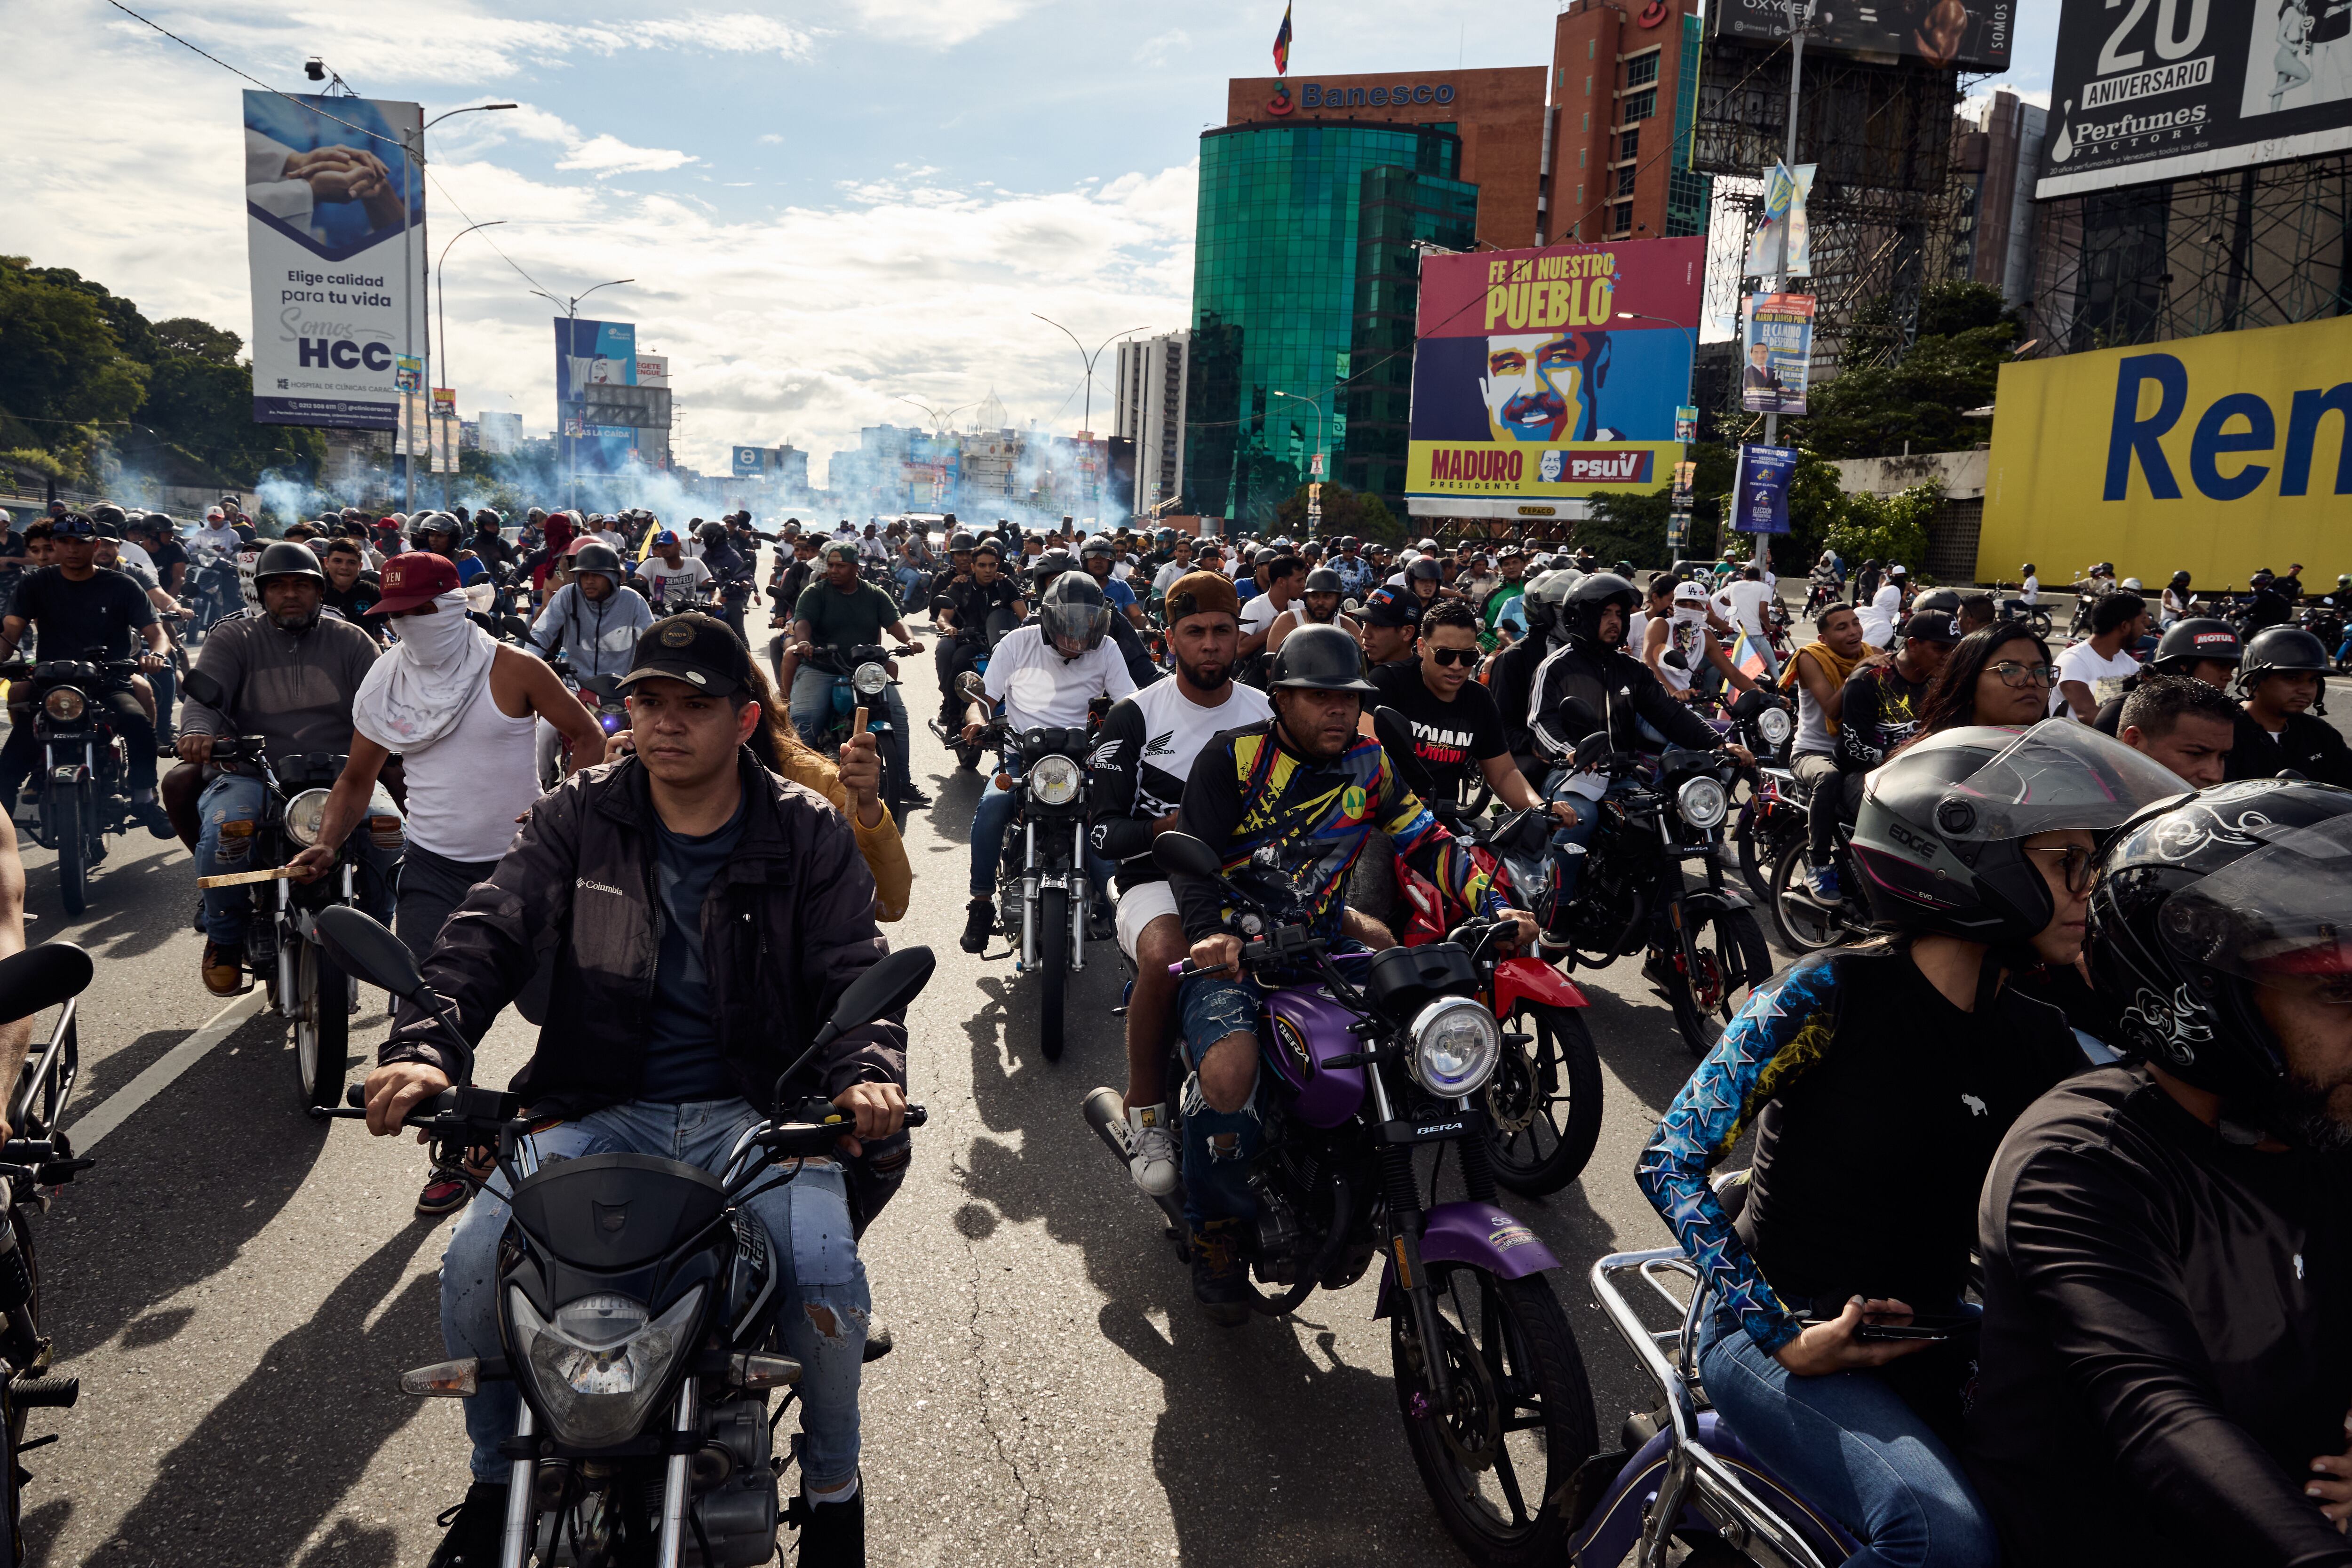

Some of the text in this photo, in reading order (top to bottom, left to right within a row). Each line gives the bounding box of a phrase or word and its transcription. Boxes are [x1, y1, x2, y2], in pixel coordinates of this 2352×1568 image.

[1991, 4, 2008, 48] SOMOS
[2097, 0, 2210, 76] 20
[2088, 60, 2207, 106] ANIVERSARIO
[1301, 83, 1455, 108] Banesco
[2074, 104, 2207, 144] Perfumes
[2073, 126, 2203, 157] FACTORY
[2074, 158, 2114, 172] perfumando
[2122, 151, 2157, 162] Venezuela
[2159, 147, 2179, 156] todos
[1488, 252, 1614, 283] FE EN NUESTRO
[288, 270, 384, 287] Elige calidad
[282, 289, 391, 307] para tu vida
[1485, 277, 1613, 330] PUEBLO
[279, 307, 354, 342] Somos
[1755, 313, 1807, 324] MARIO ALONSO PUIG
[1763, 324, 1802, 339] EL CAMINO
[1769, 337, 1800, 349] DESPERTAR
[299, 337, 392, 372] HCC
[1773, 369, 1784, 381] 14
[335, 382, 367, 392] CLÍNICAS
[1752, 447, 1788, 457] BIENVENIDOS
[1430, 449, 1524, 482] MADURO
[1430, 481, 1520, 490] PRESIDENTE
[1755, 490, 1767, 501] VOTA
[386, 572, 401, 582] VEN
[1688, 585, 1697, 596] LA
[2197, 635, 2233, 643] MOTUL
[1095, 763, 1123, 772] HONDA
[1889, 823, 1938, 859] EDGE
[586, 880, 623, 896] Columbia
[1919, 891, 1932, 900] EVO
[1279, 1023, 1310, 1063] BERA
[1417, 1122, 1462, 1135] BERA
[1491, 1217, 1512, 1226] 5G
